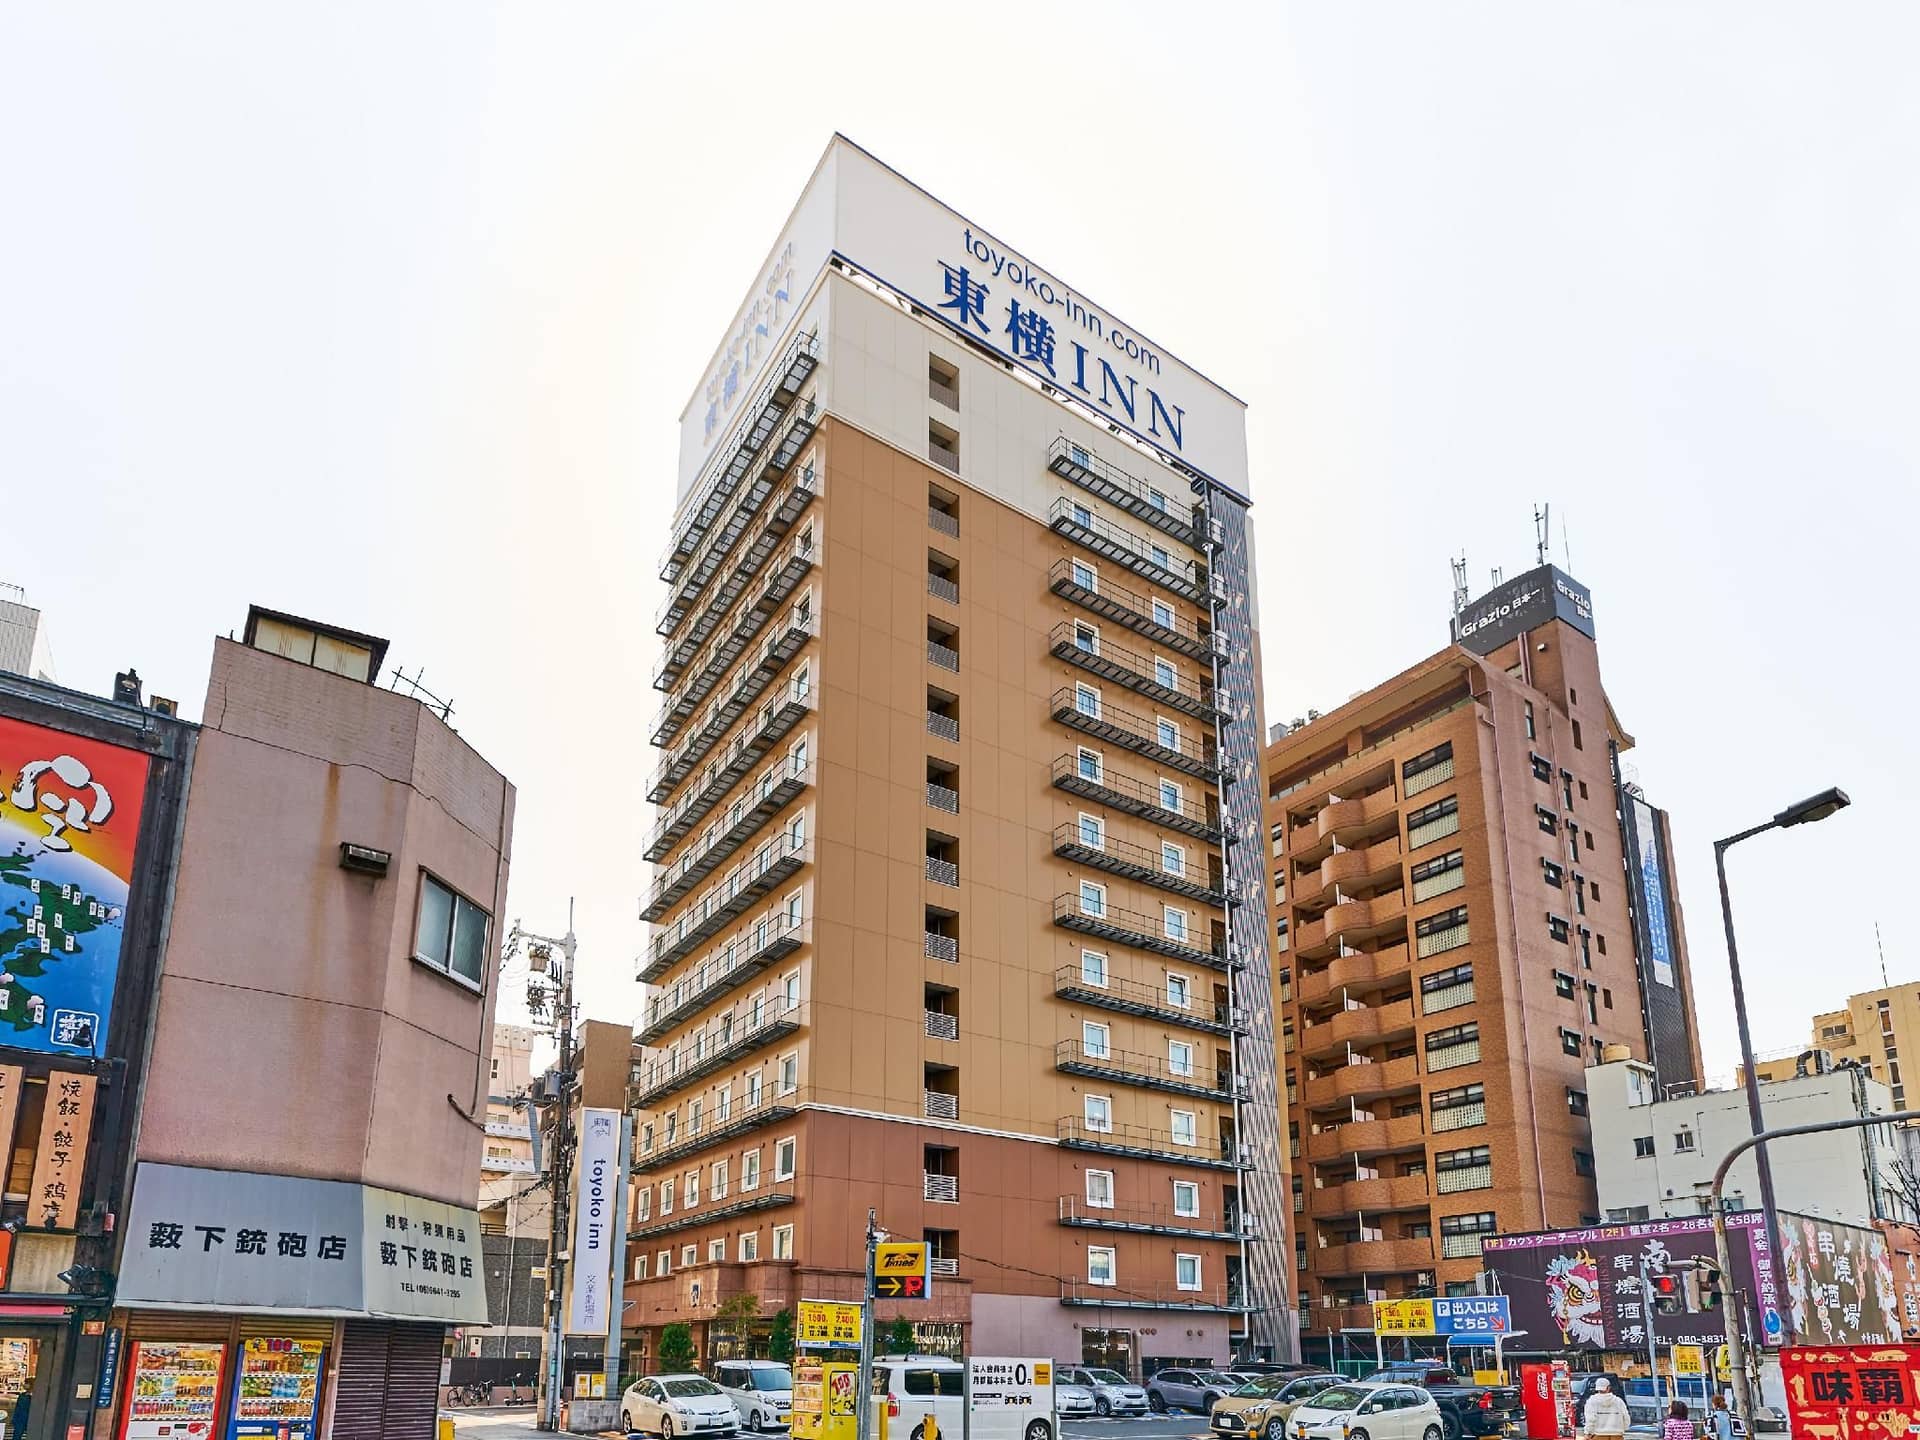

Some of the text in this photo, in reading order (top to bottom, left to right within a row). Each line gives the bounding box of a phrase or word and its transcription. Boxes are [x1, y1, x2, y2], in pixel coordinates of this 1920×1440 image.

[964, 228, 1160, 375] toyoko-inn.com
[937, 260, 1186, 451] 東横INN
[1556, 579, 1591, 610] Grazio
[1461, 605, 1510, 637] Grazio
[588, 1159, 606, 1249] toyoko inn
[884, 1253, 920, 1269] Times
[904, 1276, 924, 1297] P
[1452, 1301, 1499, 1315] 出入口は
[1453, 1317, 1489, 1330] こちら
